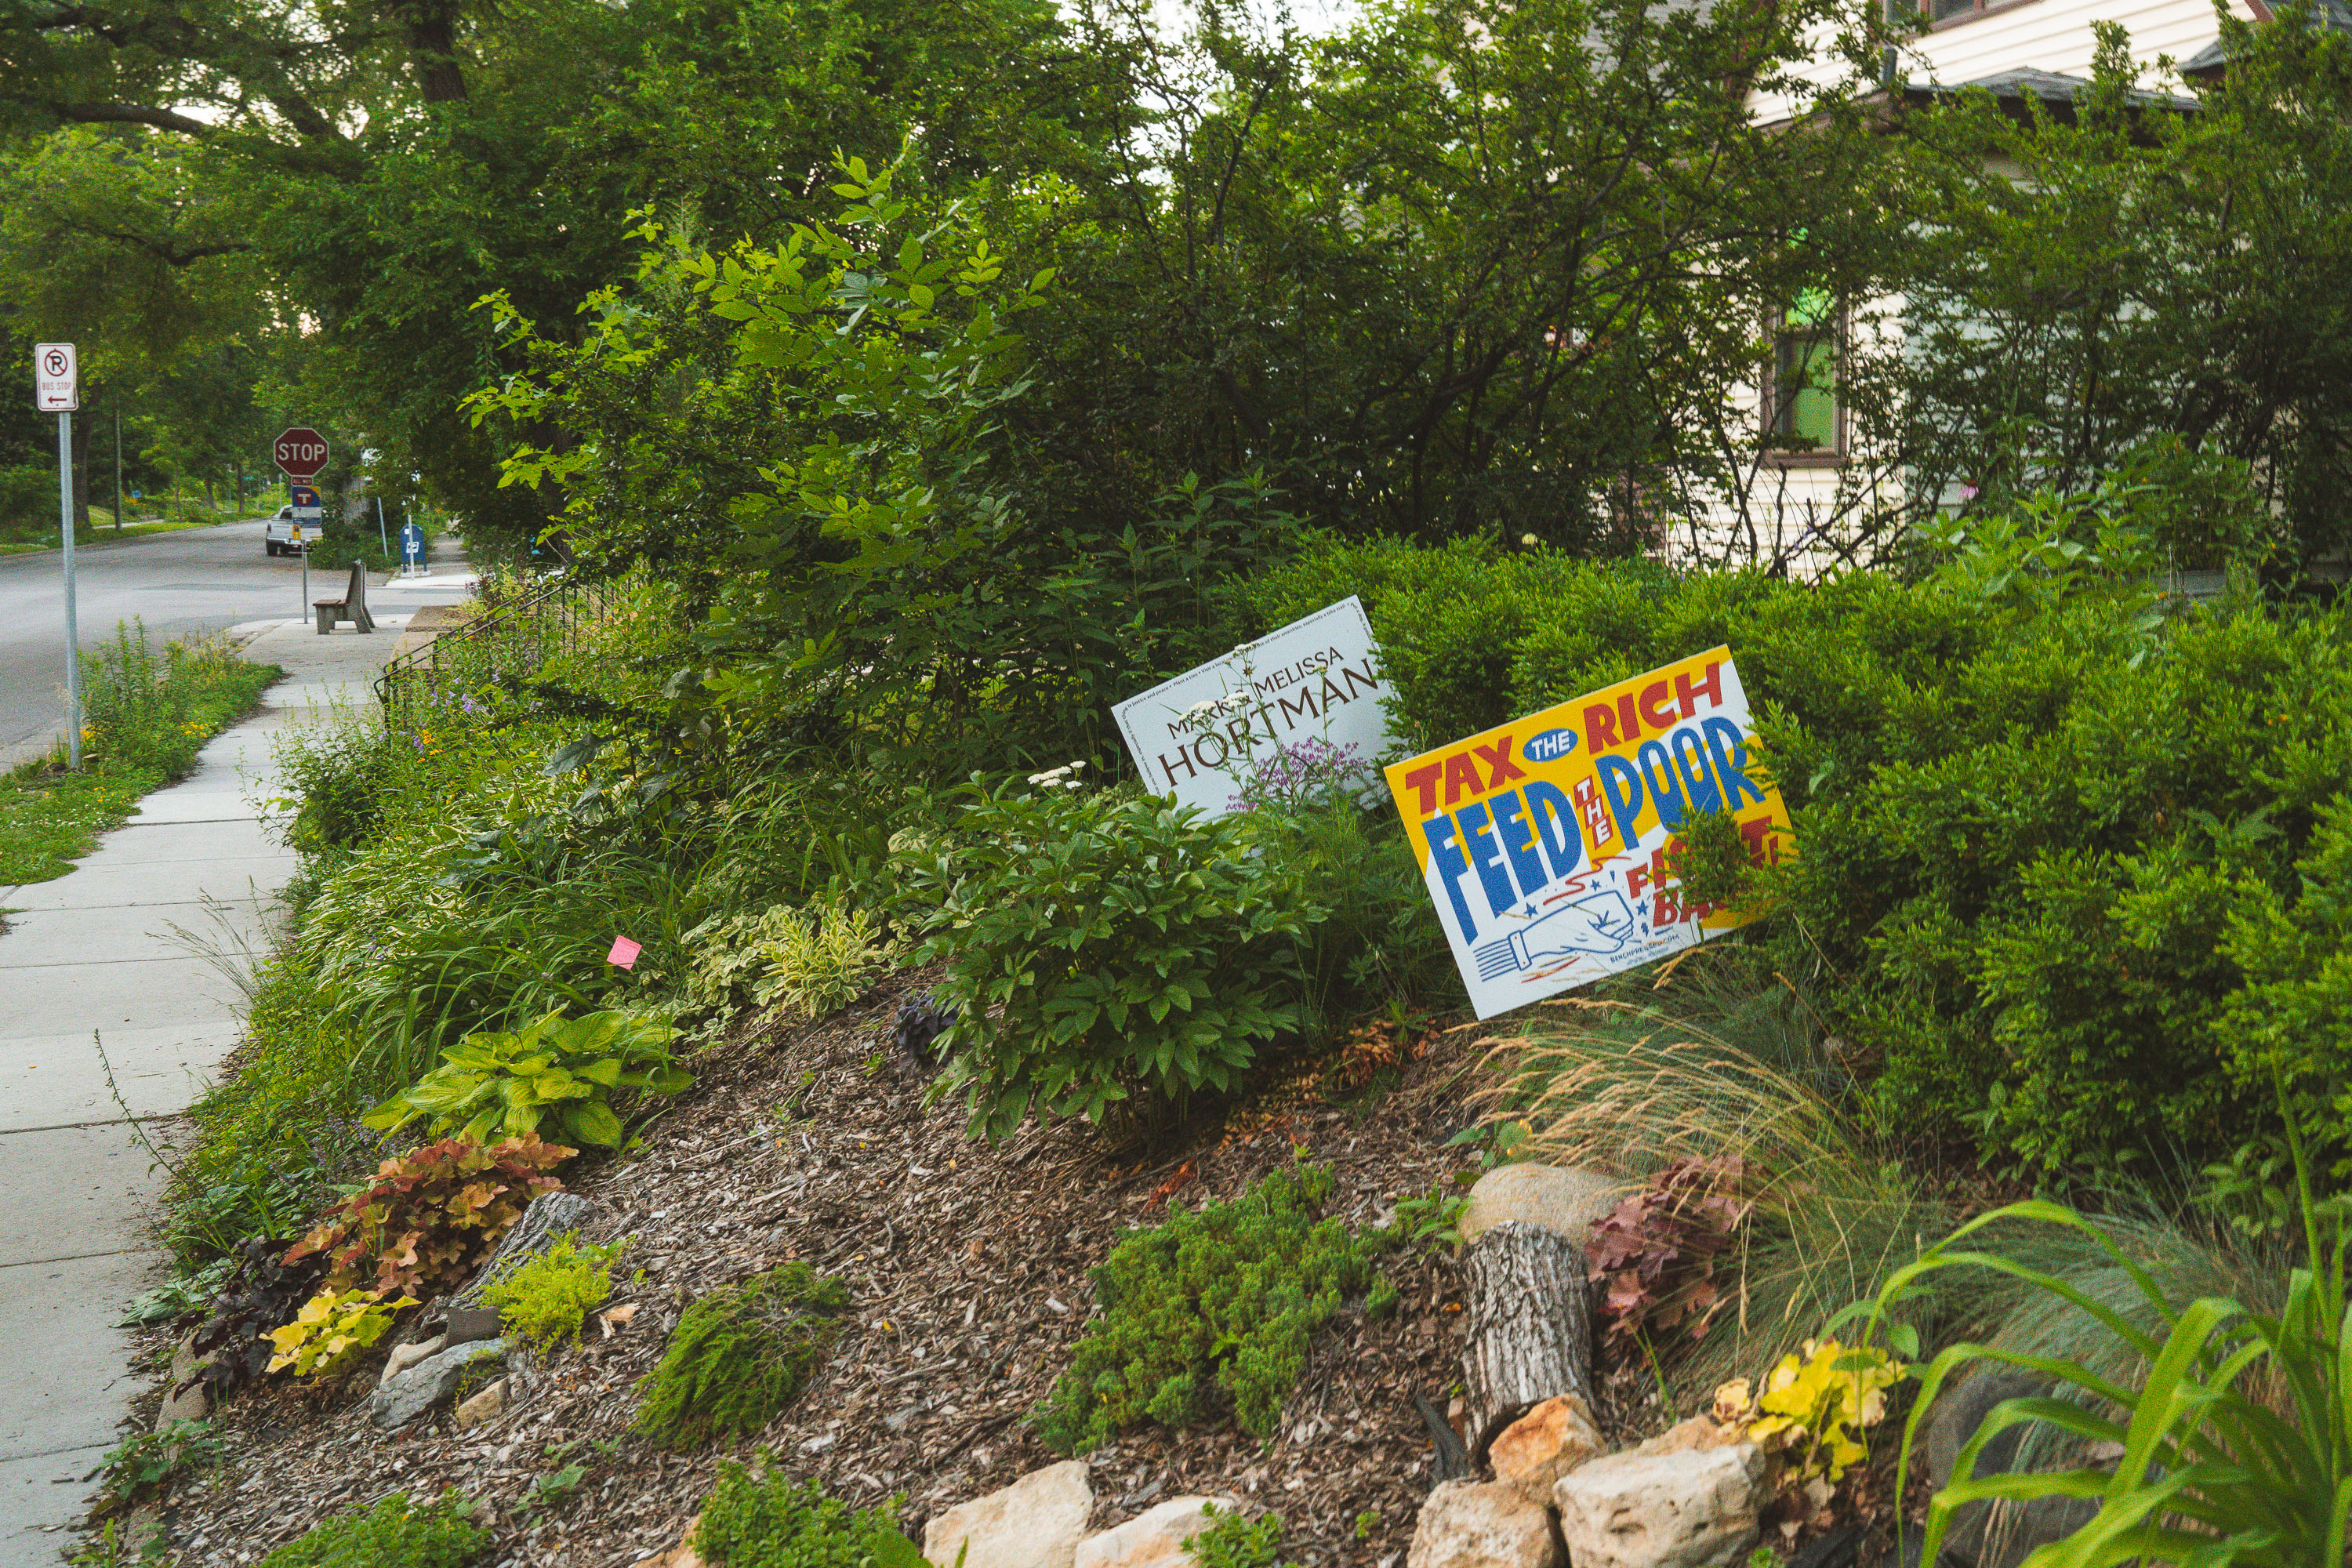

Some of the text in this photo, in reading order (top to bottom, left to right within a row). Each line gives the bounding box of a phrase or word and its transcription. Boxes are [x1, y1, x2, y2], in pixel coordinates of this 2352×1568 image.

[278, 443, 325, 461] STOP
[1131, 696, 1147, 707] justice
[1156, 686, 1169, 695] peace
[1172, 678, 1185, 687] Plant
[1302, 614, 1323, 627] especially
[1254, 646, 1345, 698] MELISSA
[1157, 658, 1380, 787] HORTMAN
[1406, 661, 1722, 815] TAX THE RICH
[1421, 717, 1766, 946] FEED THE POOR
[1625, 815, 1772, 899] FIT
